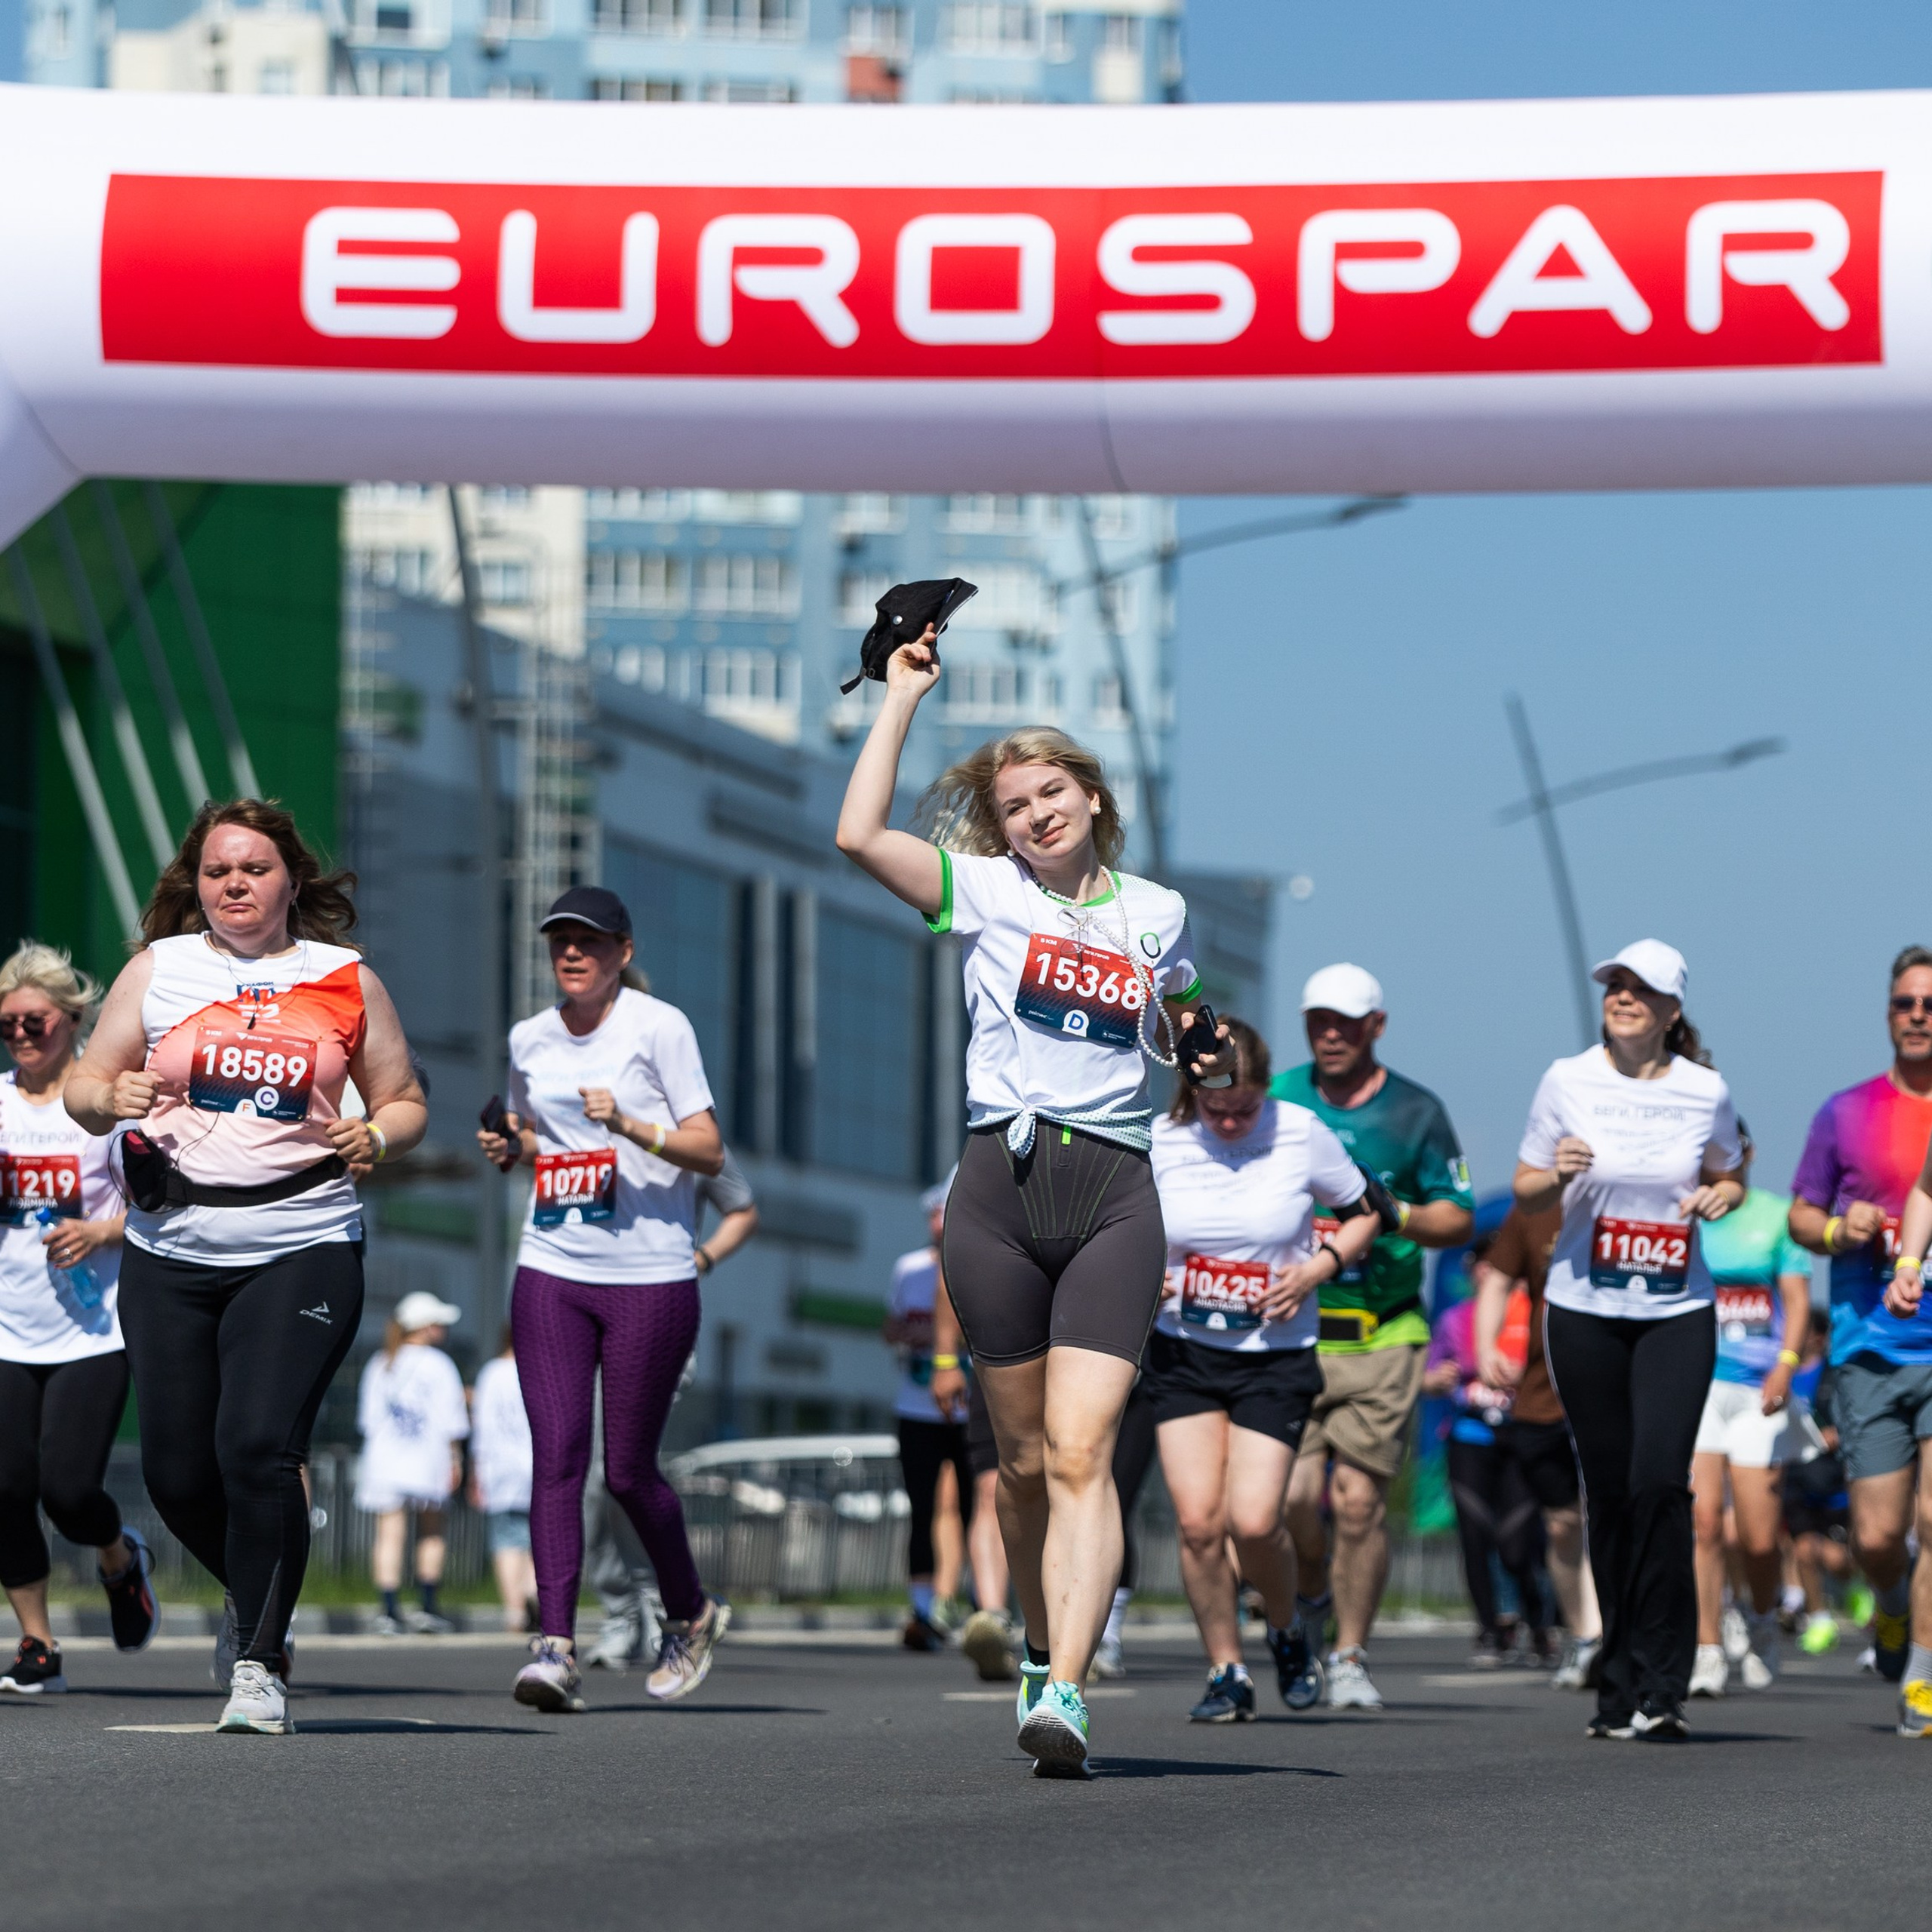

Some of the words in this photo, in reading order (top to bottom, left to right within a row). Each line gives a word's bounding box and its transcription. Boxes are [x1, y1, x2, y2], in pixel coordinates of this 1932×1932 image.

[301, 198, 1852, 348] EUROSPAR
[1036, 952, 1141, 1010] 15368
[1068, 1013, 1084, 1029] D
[202, 1044, 308, 1087] 18589
[242, 1103, 251, 1112] F
[540, 1163, 613, 1198] 10719
[1598, 1232, 1687, 1266] 11042
[1187, 1268, 1265, 1304] 10425
[299, 1309, 333, 1324] DEMIX
